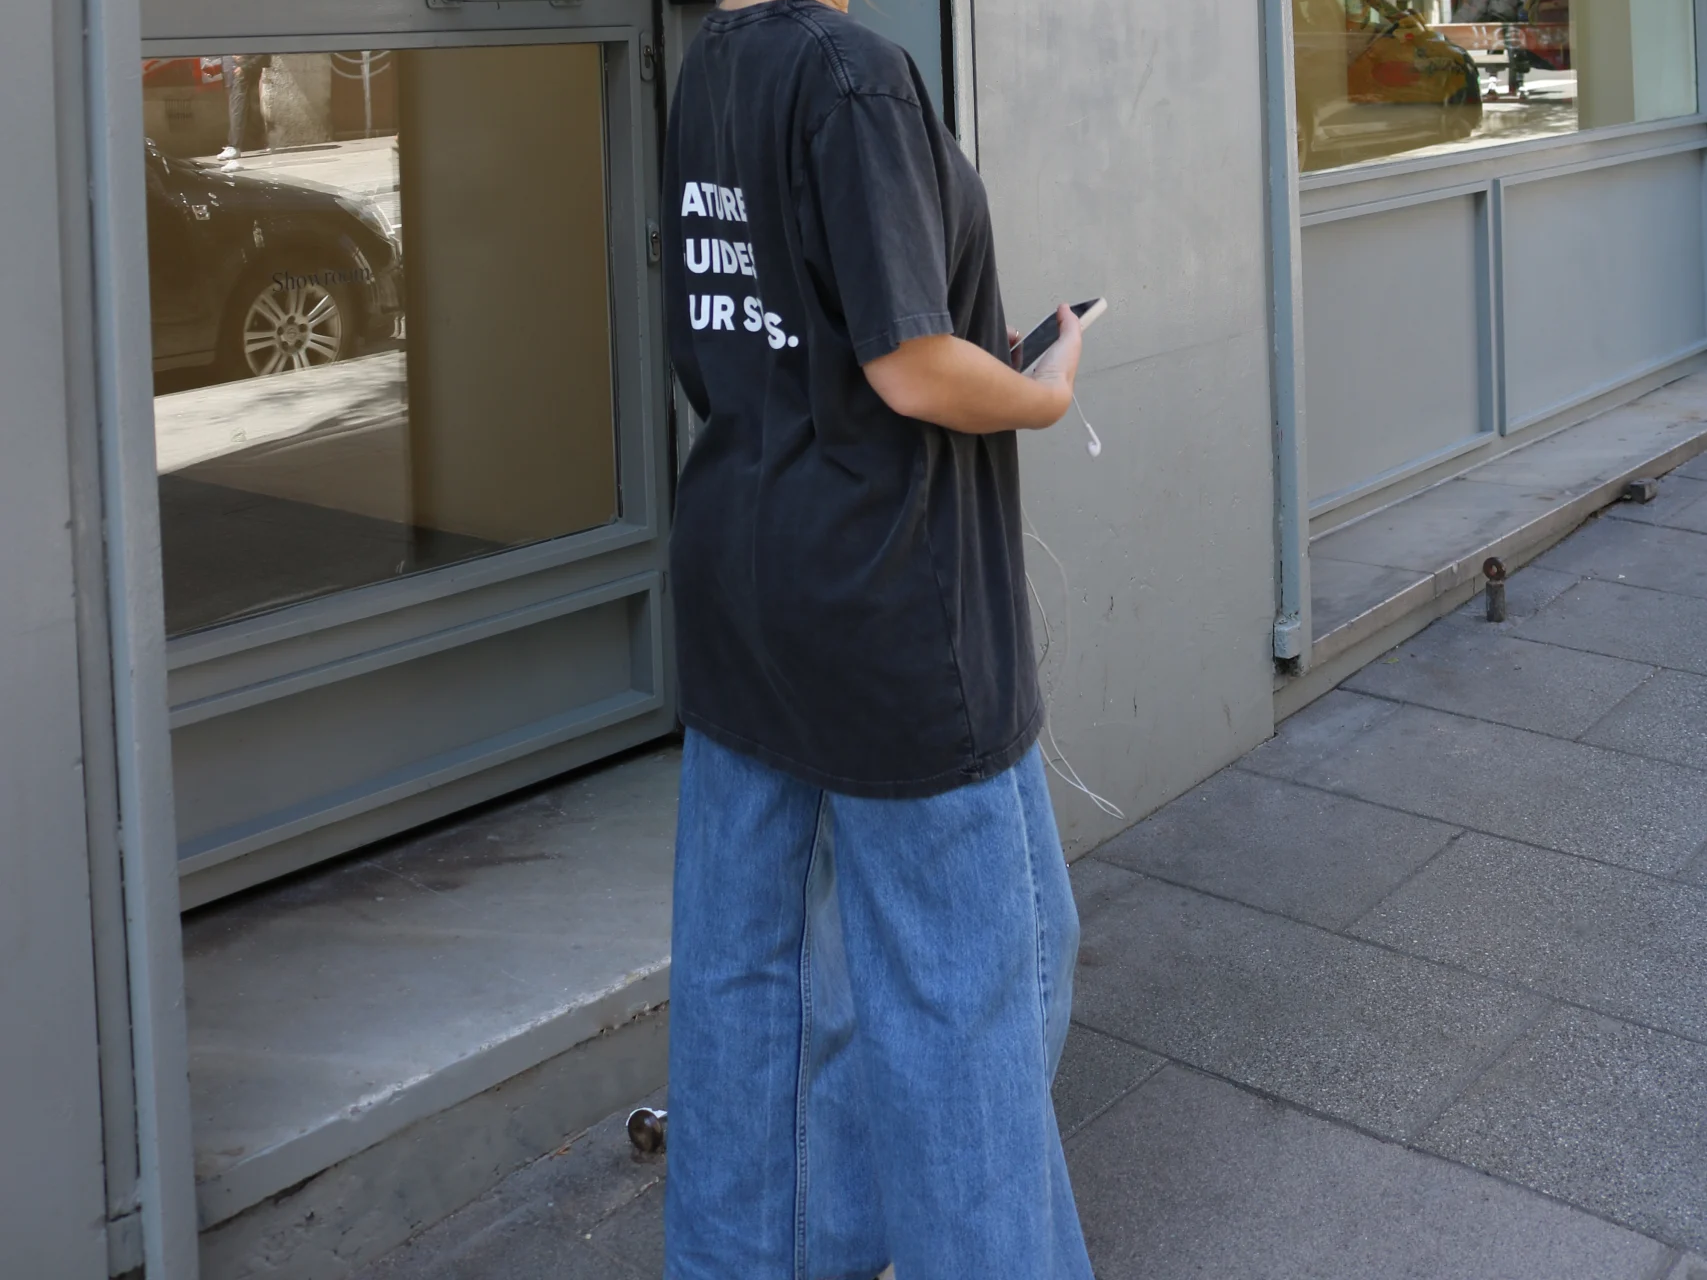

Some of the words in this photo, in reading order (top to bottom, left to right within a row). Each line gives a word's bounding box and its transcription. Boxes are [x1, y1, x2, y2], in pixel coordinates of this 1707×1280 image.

[681, 181, 748, 222] ATURE
[683, 238, 758, 280] UIDE
[689, 294, 736, 331] UR
